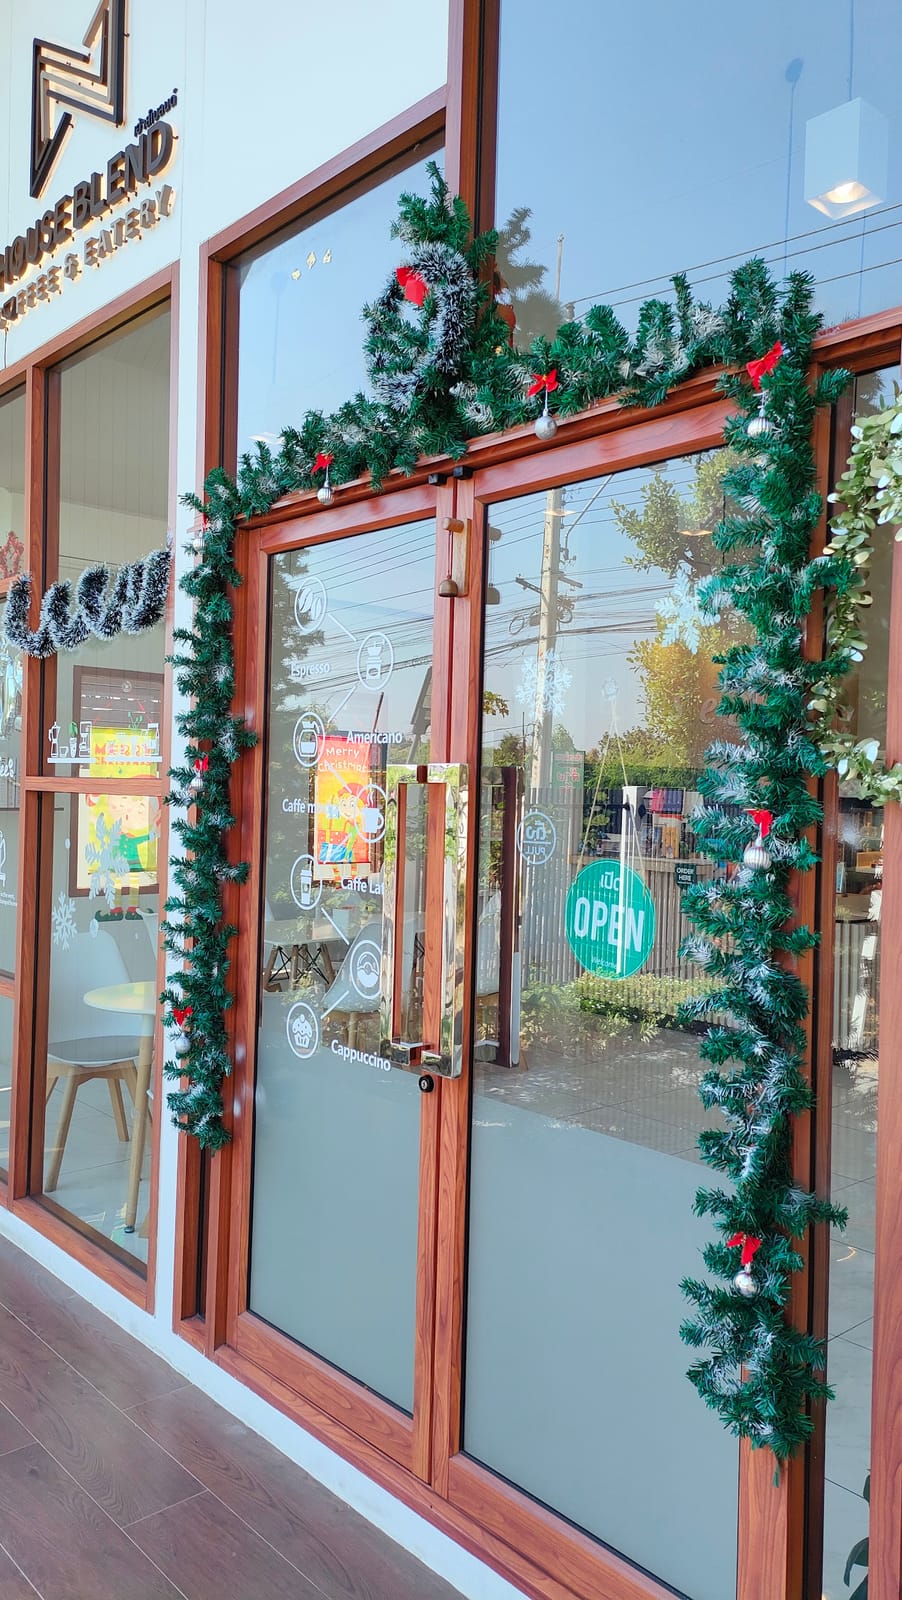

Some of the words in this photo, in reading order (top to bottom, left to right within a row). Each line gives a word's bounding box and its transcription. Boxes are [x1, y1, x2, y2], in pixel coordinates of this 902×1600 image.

[84, 184, 173, 266] EATERY
[290, 660, 331, 681] Espresso
[346, 730, 403, 745] Americano
[326, 746, 360, 758] Merry
[282, 798, 306, 813] Caffe
[341, 875, 367, 893] Caffe
[574, 896, 645, 953] OPEN
[331, 1039, 391, 1072] Cappuccino
